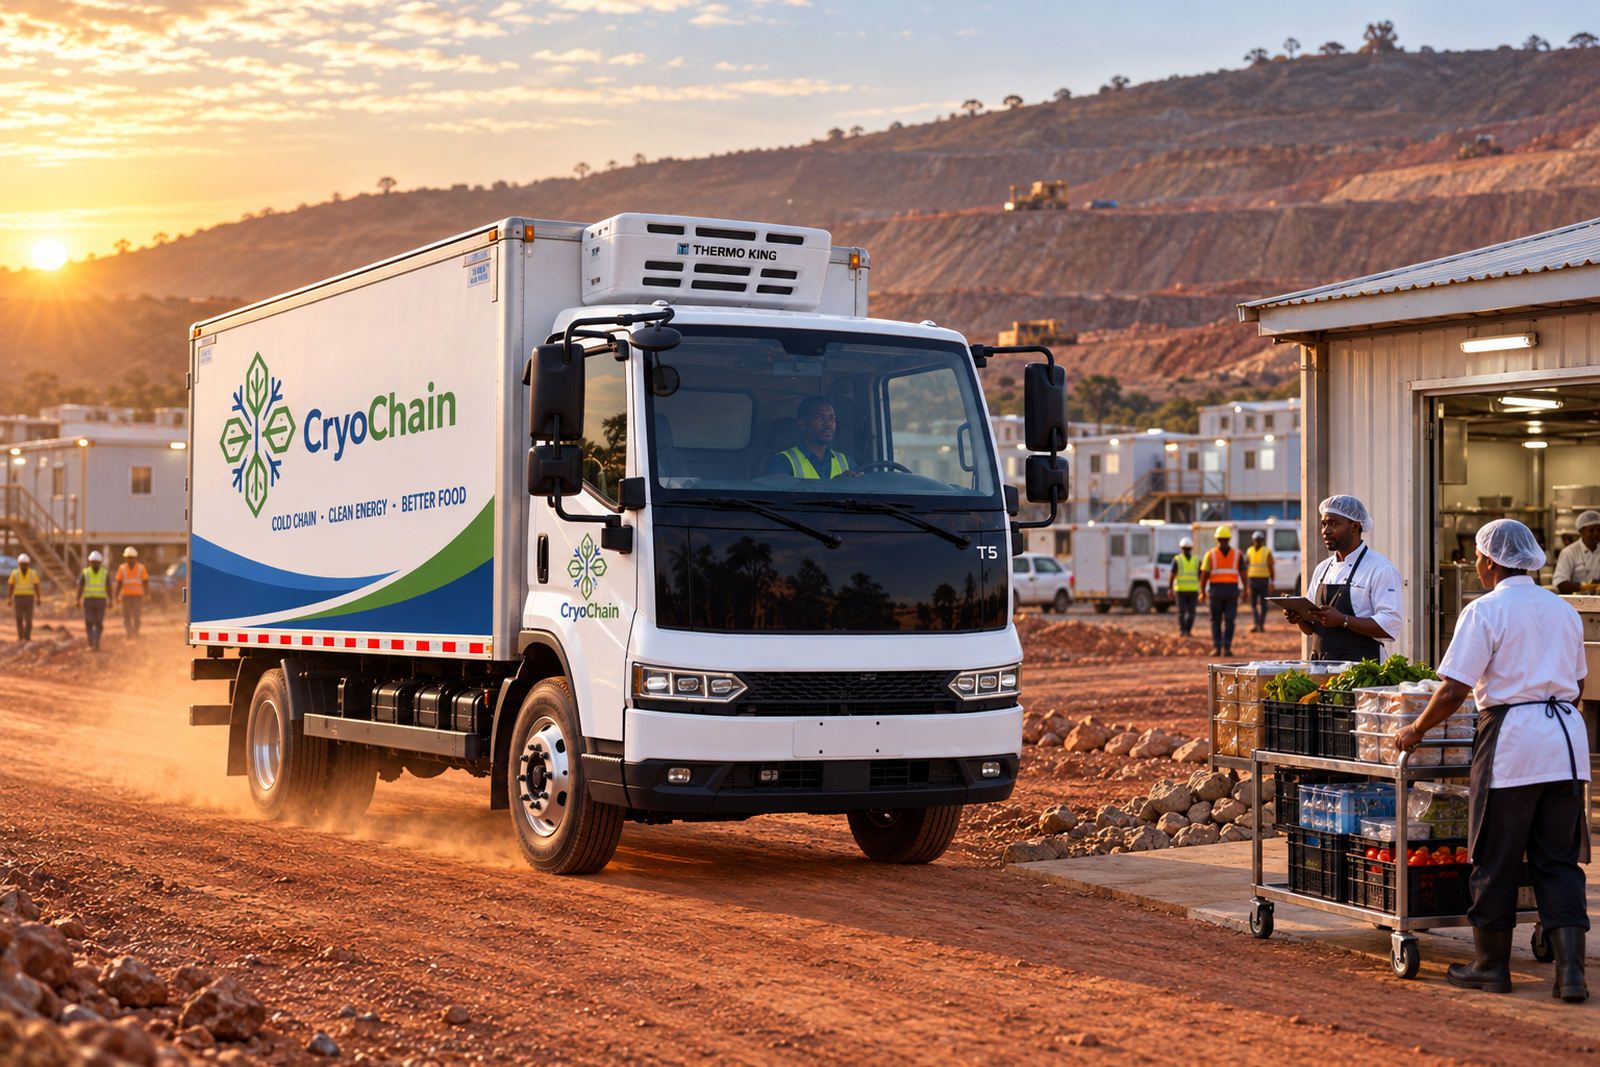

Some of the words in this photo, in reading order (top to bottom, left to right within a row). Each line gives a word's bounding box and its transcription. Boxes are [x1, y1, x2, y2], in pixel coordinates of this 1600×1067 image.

[693, 245, 745, 258] THERMO
[749, 249, 777, 260] KING
[304, 381, 456, 462] CryoChain
[271, 514, 292, 531] COLD
[293, 511, 317, 528] CHAIN
[328, 504, 353, 523] CLEAN
[355, 498, 388, 519] ENERGY
[402, 491, 436, 512] BETTER
[438, 486, 466, 507] FOOD
[976, 545, 998, 559] T5
[560, 602, 619, 622] CryoChain
